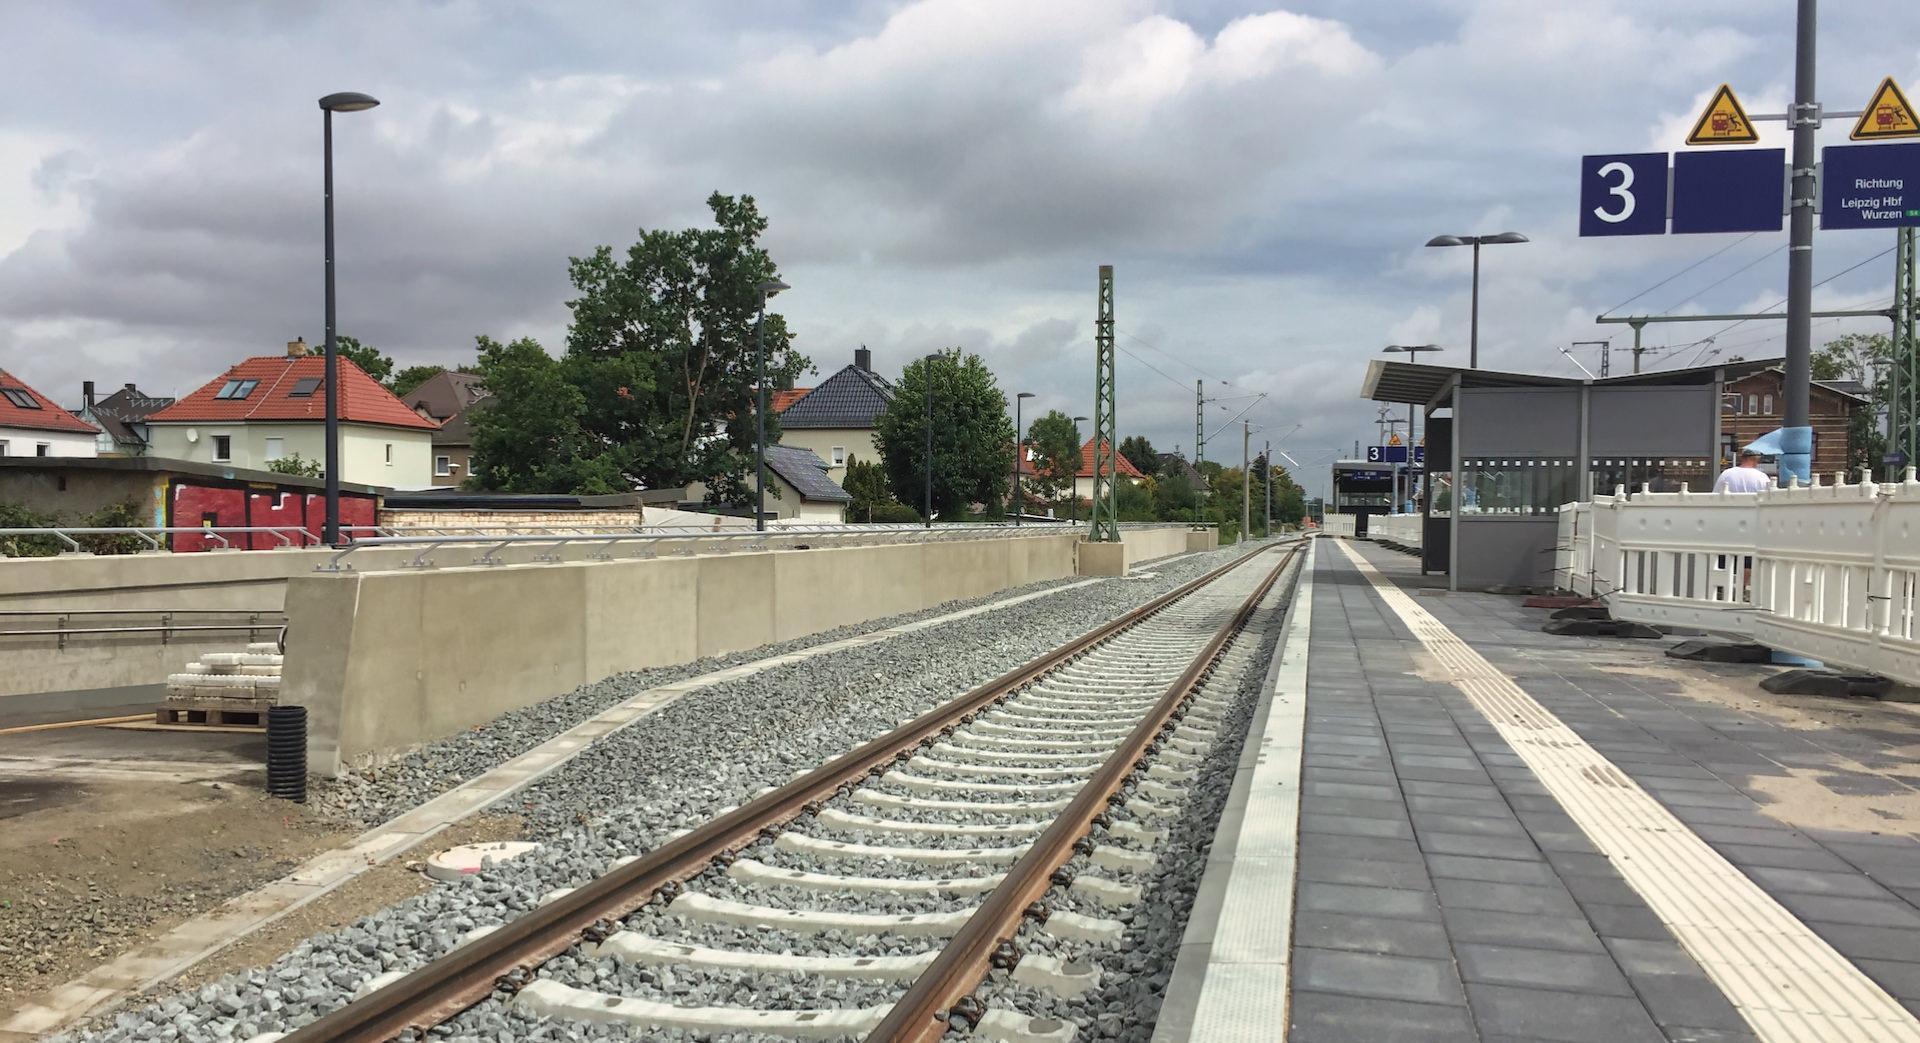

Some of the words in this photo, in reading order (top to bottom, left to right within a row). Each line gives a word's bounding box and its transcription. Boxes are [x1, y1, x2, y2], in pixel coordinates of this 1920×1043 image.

[1855, 178, 1903, 190] Richtung
[1593, 161, 1636, 223] 3
[1841, 197, 1880, 209] Leipzig
[1882, 196, 1903, 207] Hbf
[1861, 209, 1903, 220] Wurzen
[1369, 447, 1379, 460] 3
